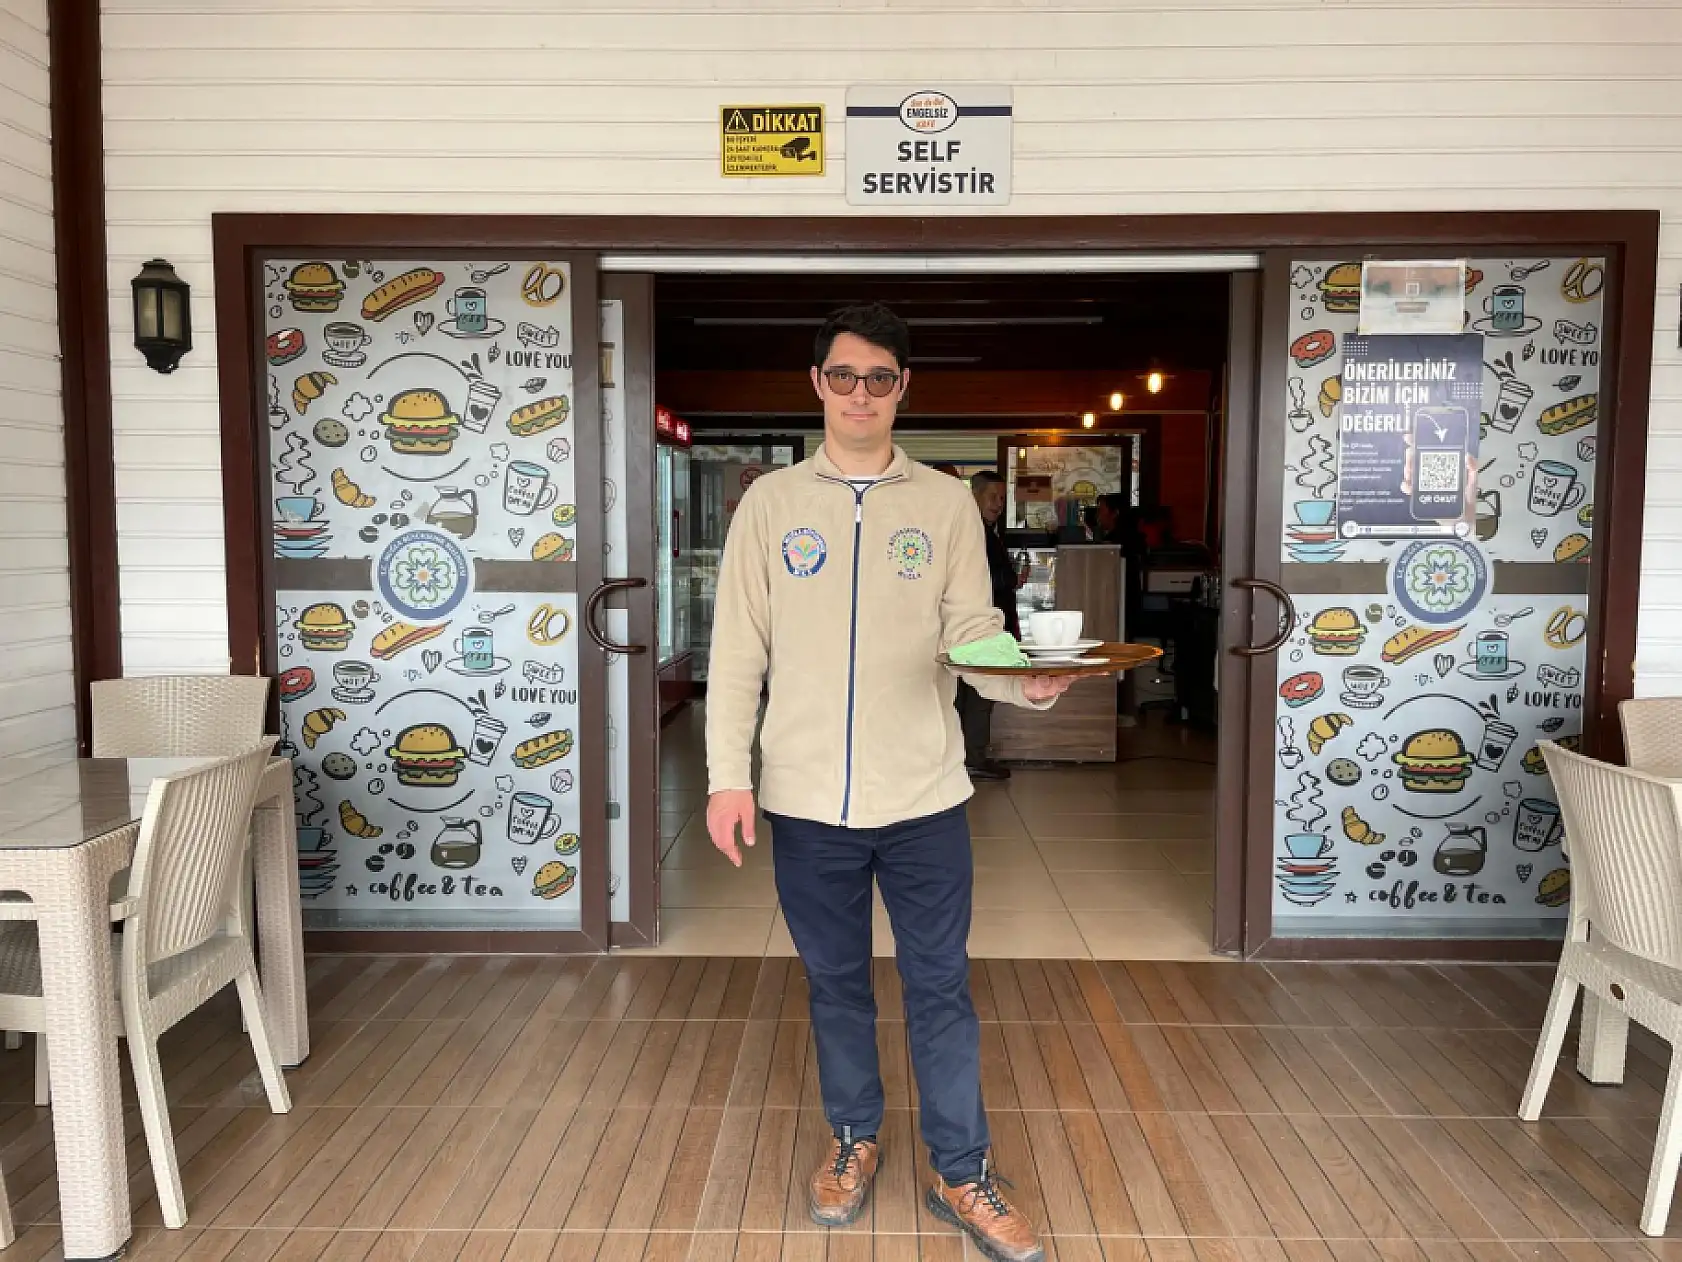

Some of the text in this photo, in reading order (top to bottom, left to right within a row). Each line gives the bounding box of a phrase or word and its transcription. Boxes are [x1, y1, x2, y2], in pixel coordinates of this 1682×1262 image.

[752, 109, 819, 131] DİKKAT
[897, 141, 961, 162] SELF
[862, 167, 995, 193] SERVİSTİR
[505, 350, 573, 369] LOVE YOU
[1540, 348, 1578, 366] LOVE
[1344, 358, 1457, 381] ÖNERİLERİNİZ
[1343, 382, 1429, 407] BİZİM İÇİN
[1342, 406, 1410, 433] DEĞERLİ
[1419, 495, 1432, 504] QR
[511, 687, 577, 705] LOVE YOU
[1524, 691, 1561, 709] LOVE
[368, 872, 503, 901] coffee & tea
[1368, 879, 1507, 909] coffee & tea
